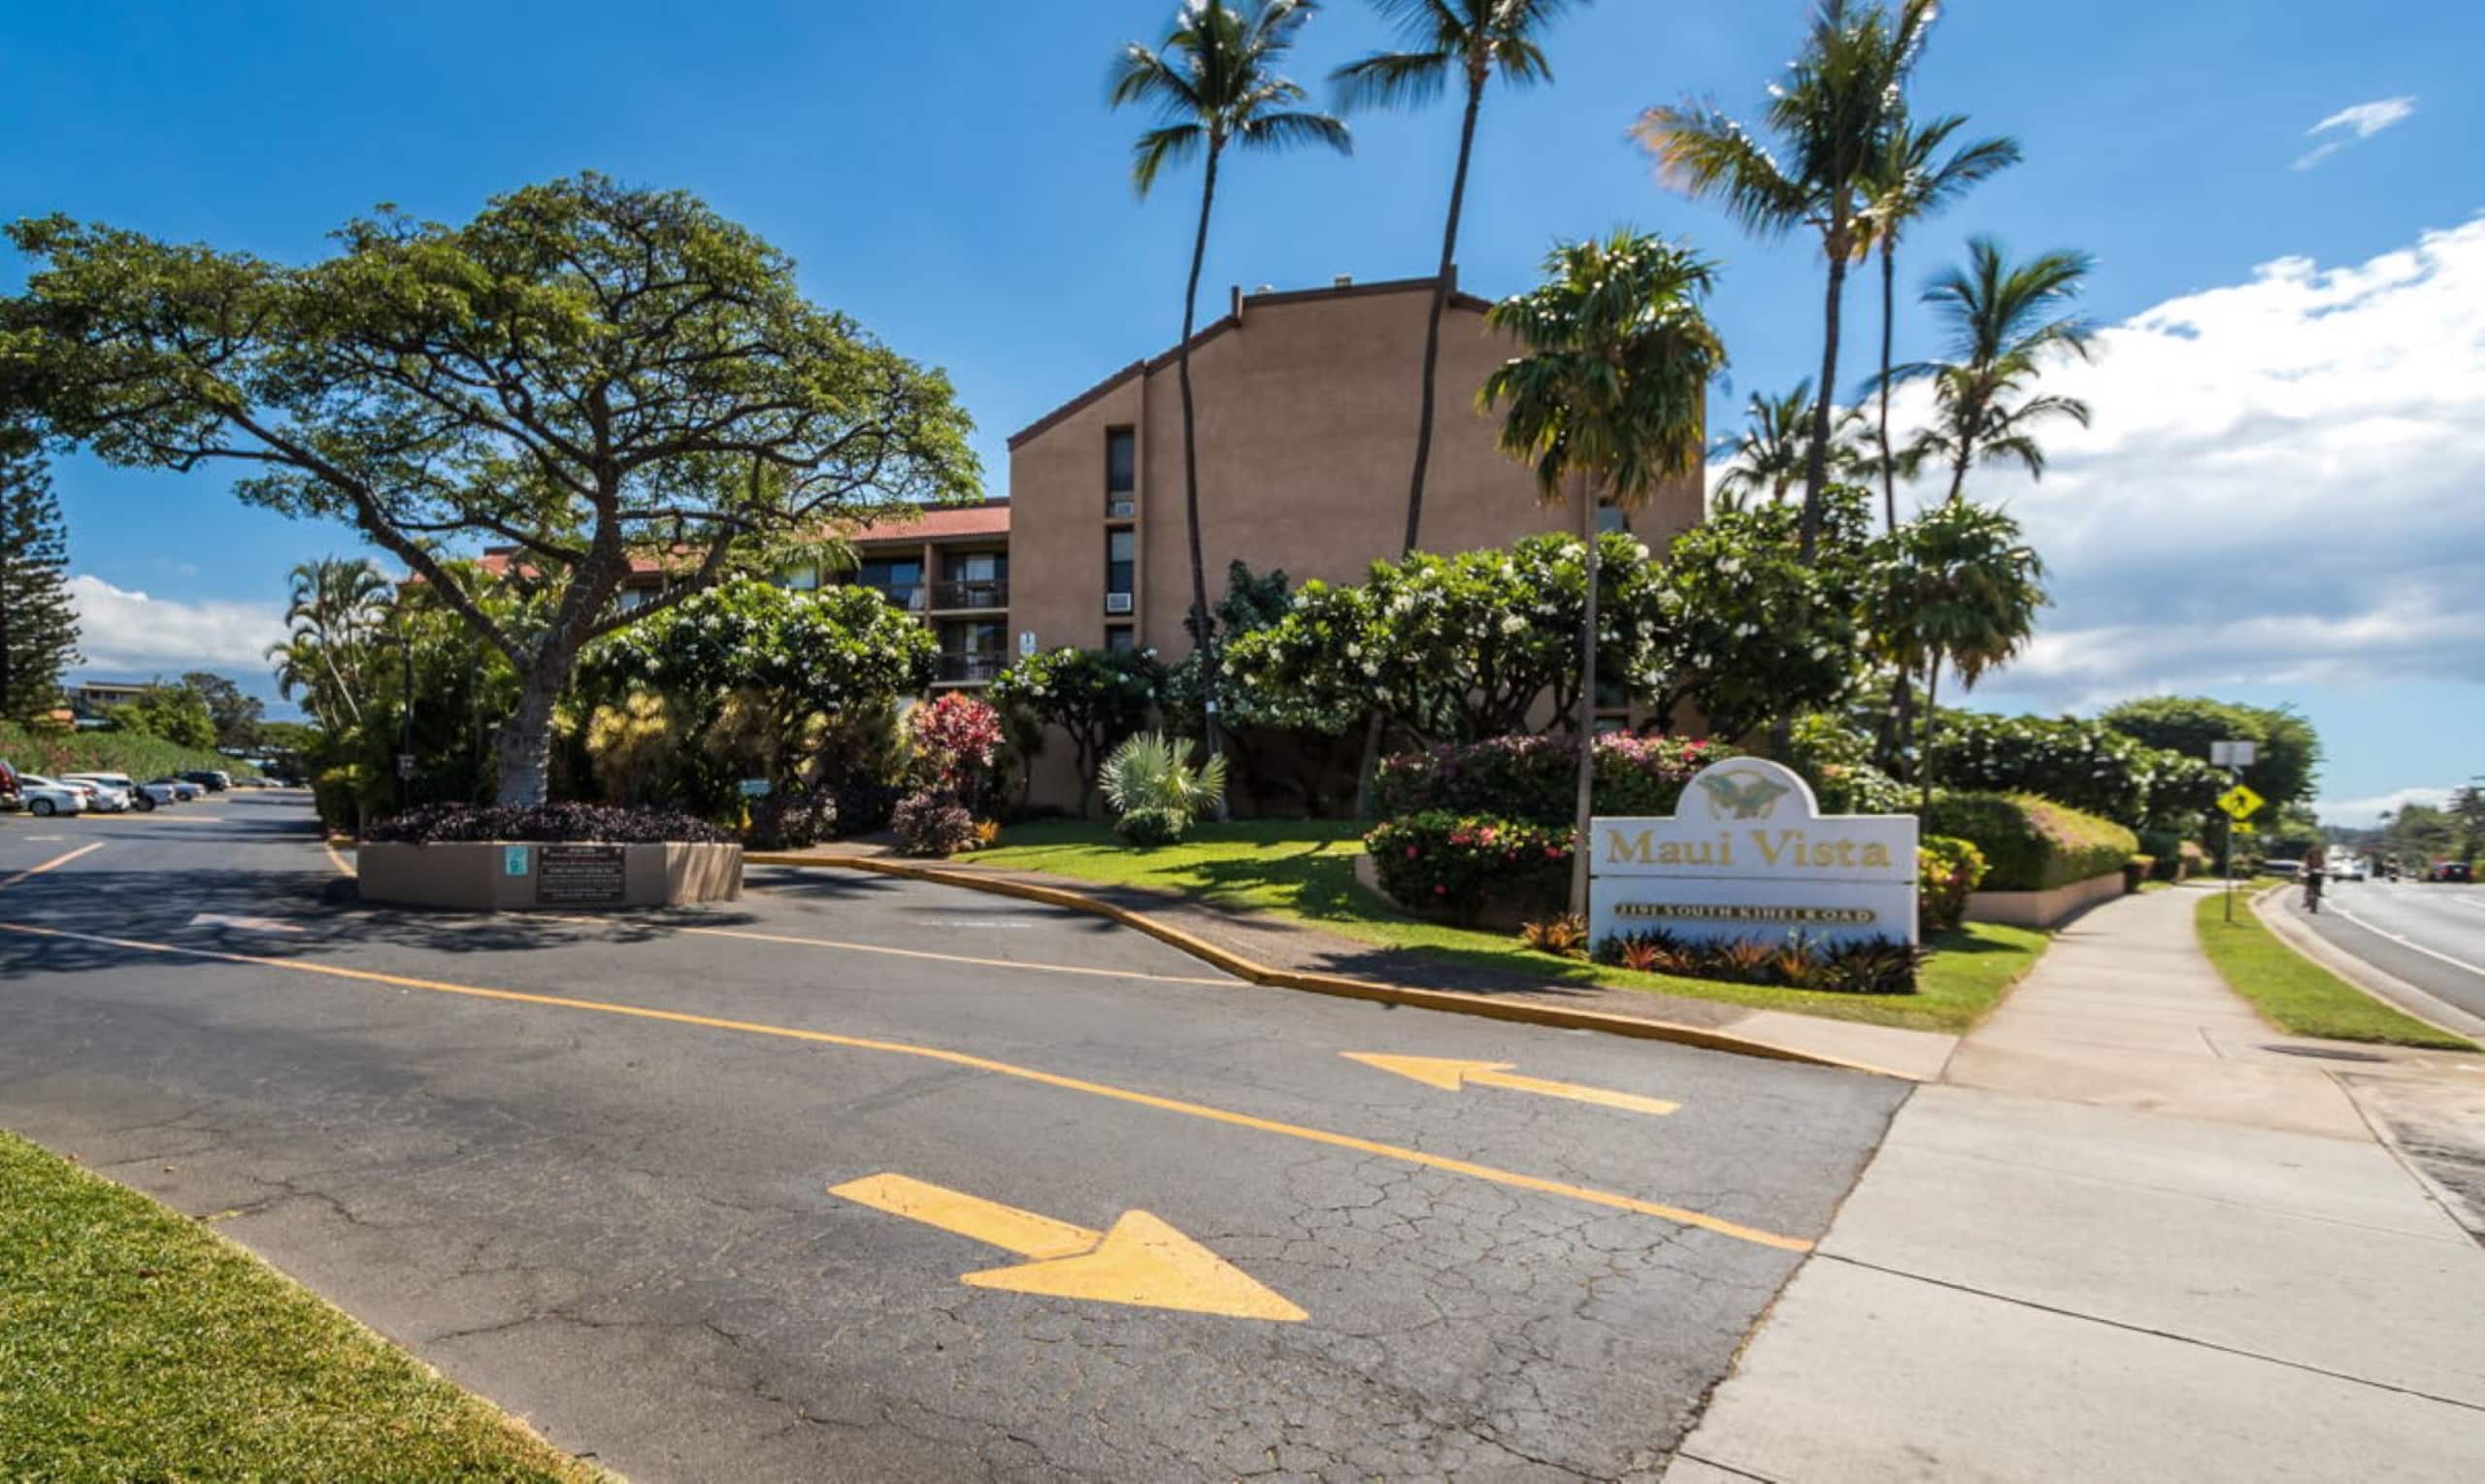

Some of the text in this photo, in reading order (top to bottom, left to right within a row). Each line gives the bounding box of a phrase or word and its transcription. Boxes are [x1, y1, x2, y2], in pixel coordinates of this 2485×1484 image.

[1607, 828, 1892, 868] Maui Vista
[1663, 905, 1731, 918] SOUTH
[1805, 907, 1872, 922] ROAD
